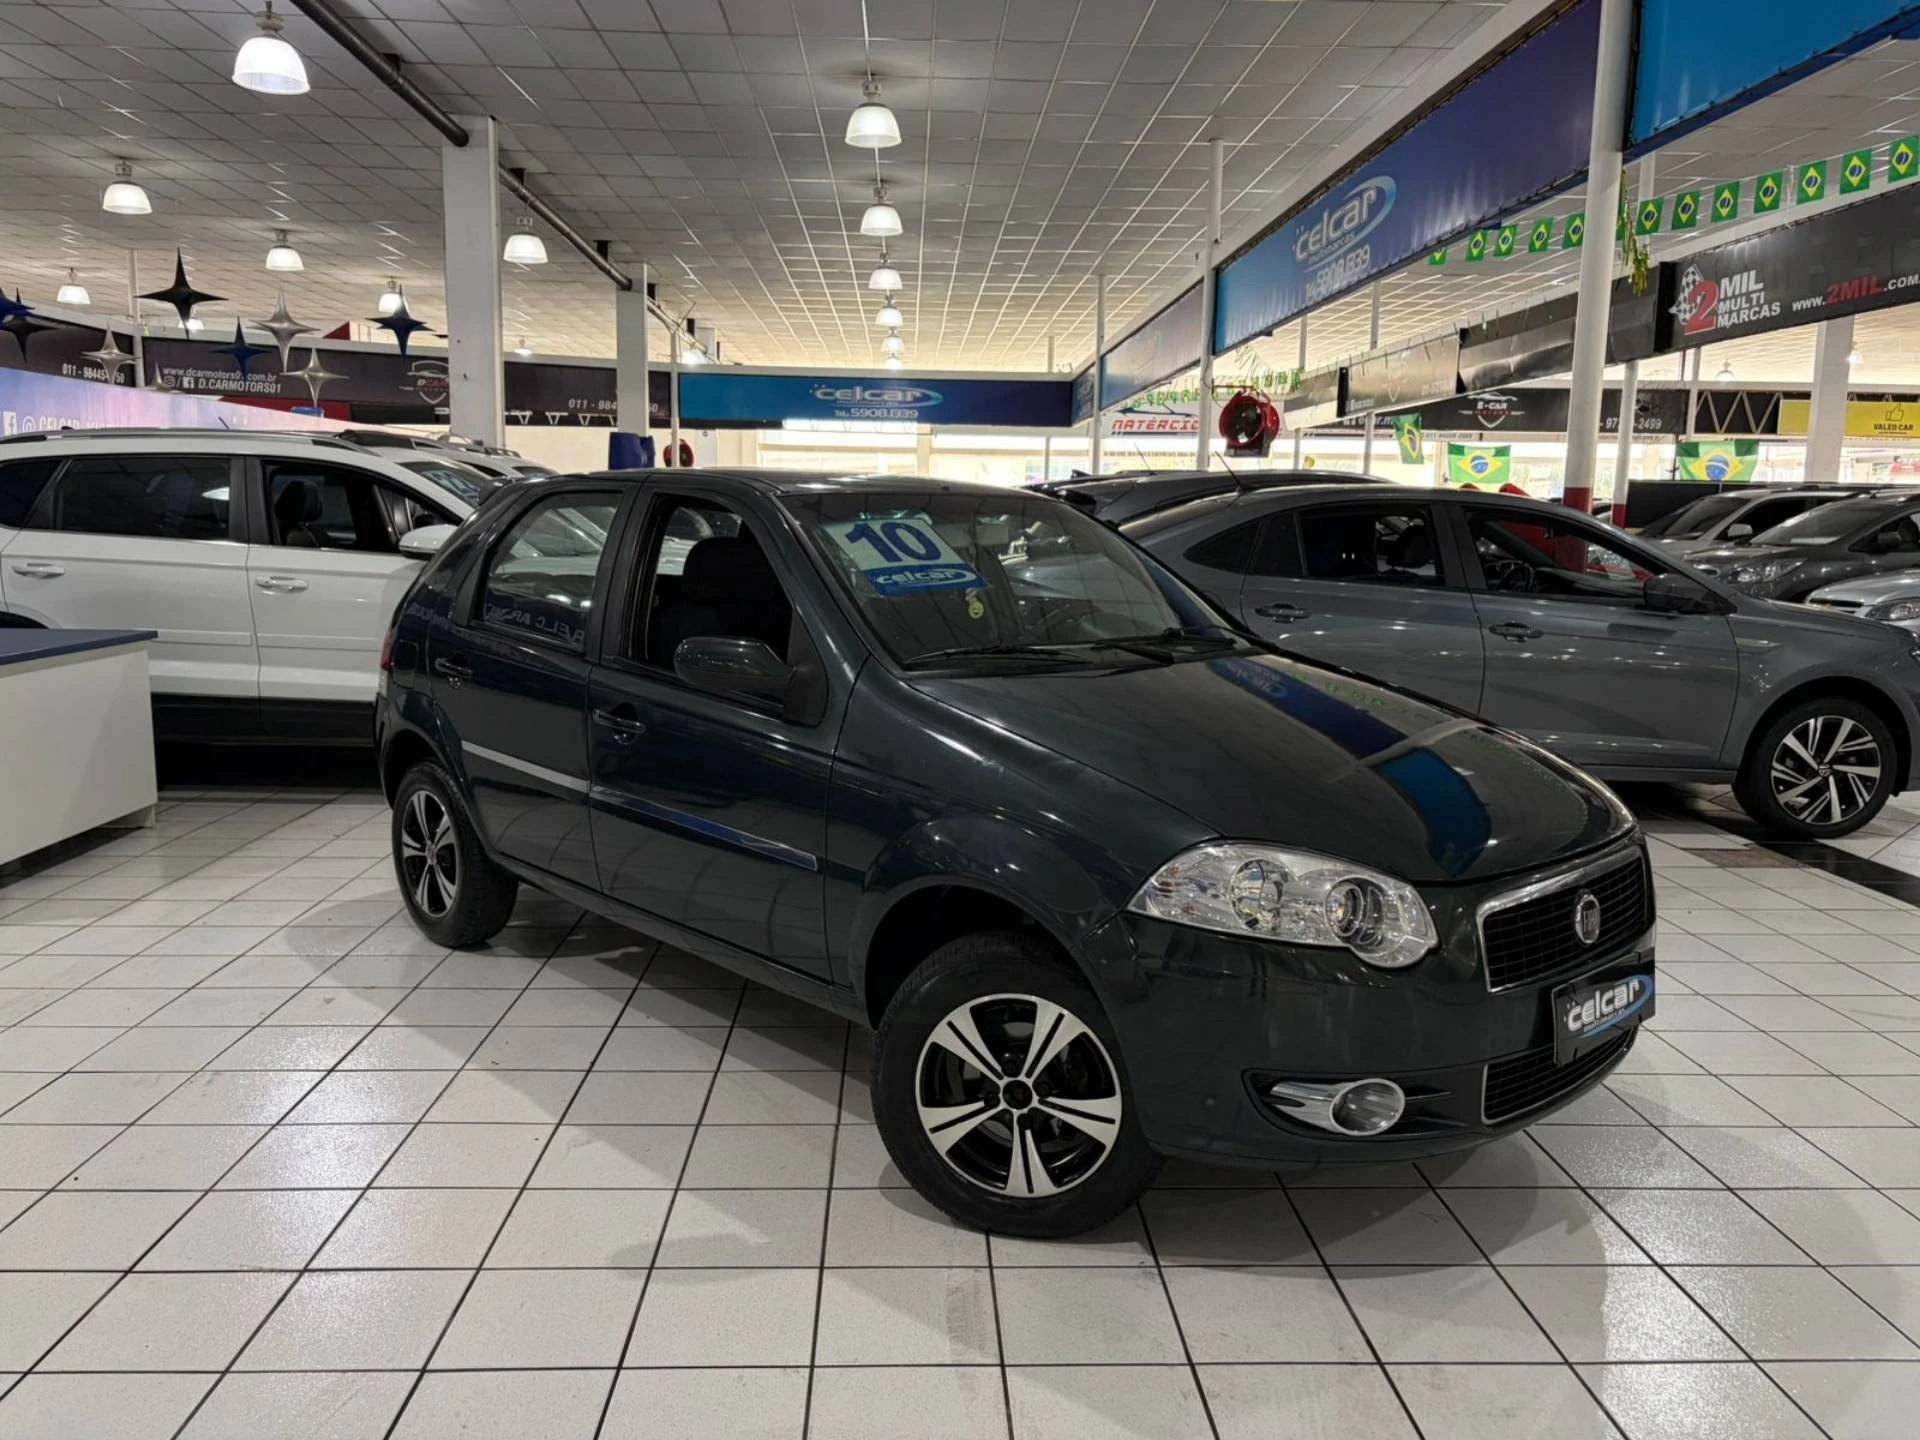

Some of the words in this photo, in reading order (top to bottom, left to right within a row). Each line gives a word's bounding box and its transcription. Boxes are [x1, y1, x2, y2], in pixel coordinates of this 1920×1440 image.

[1296, 187, 1377, 261] celcar
[1683, 280, 1718, 335] 2
[1720, 269, 1764, 299] MIL
[1718, 291, 1765, 314] MULTI
[1717, 302, 1781, 328] MARCAS
[198, 378, 281, 393] D.CARMOTORS01
[815, 386, 923, 402] celcar
[568, 398, 588, 409] 011
[844, 521, 942, 563] 10
[876, 570, 957, 585] celcar
[1568, 978, 1640, 1031] celcar
